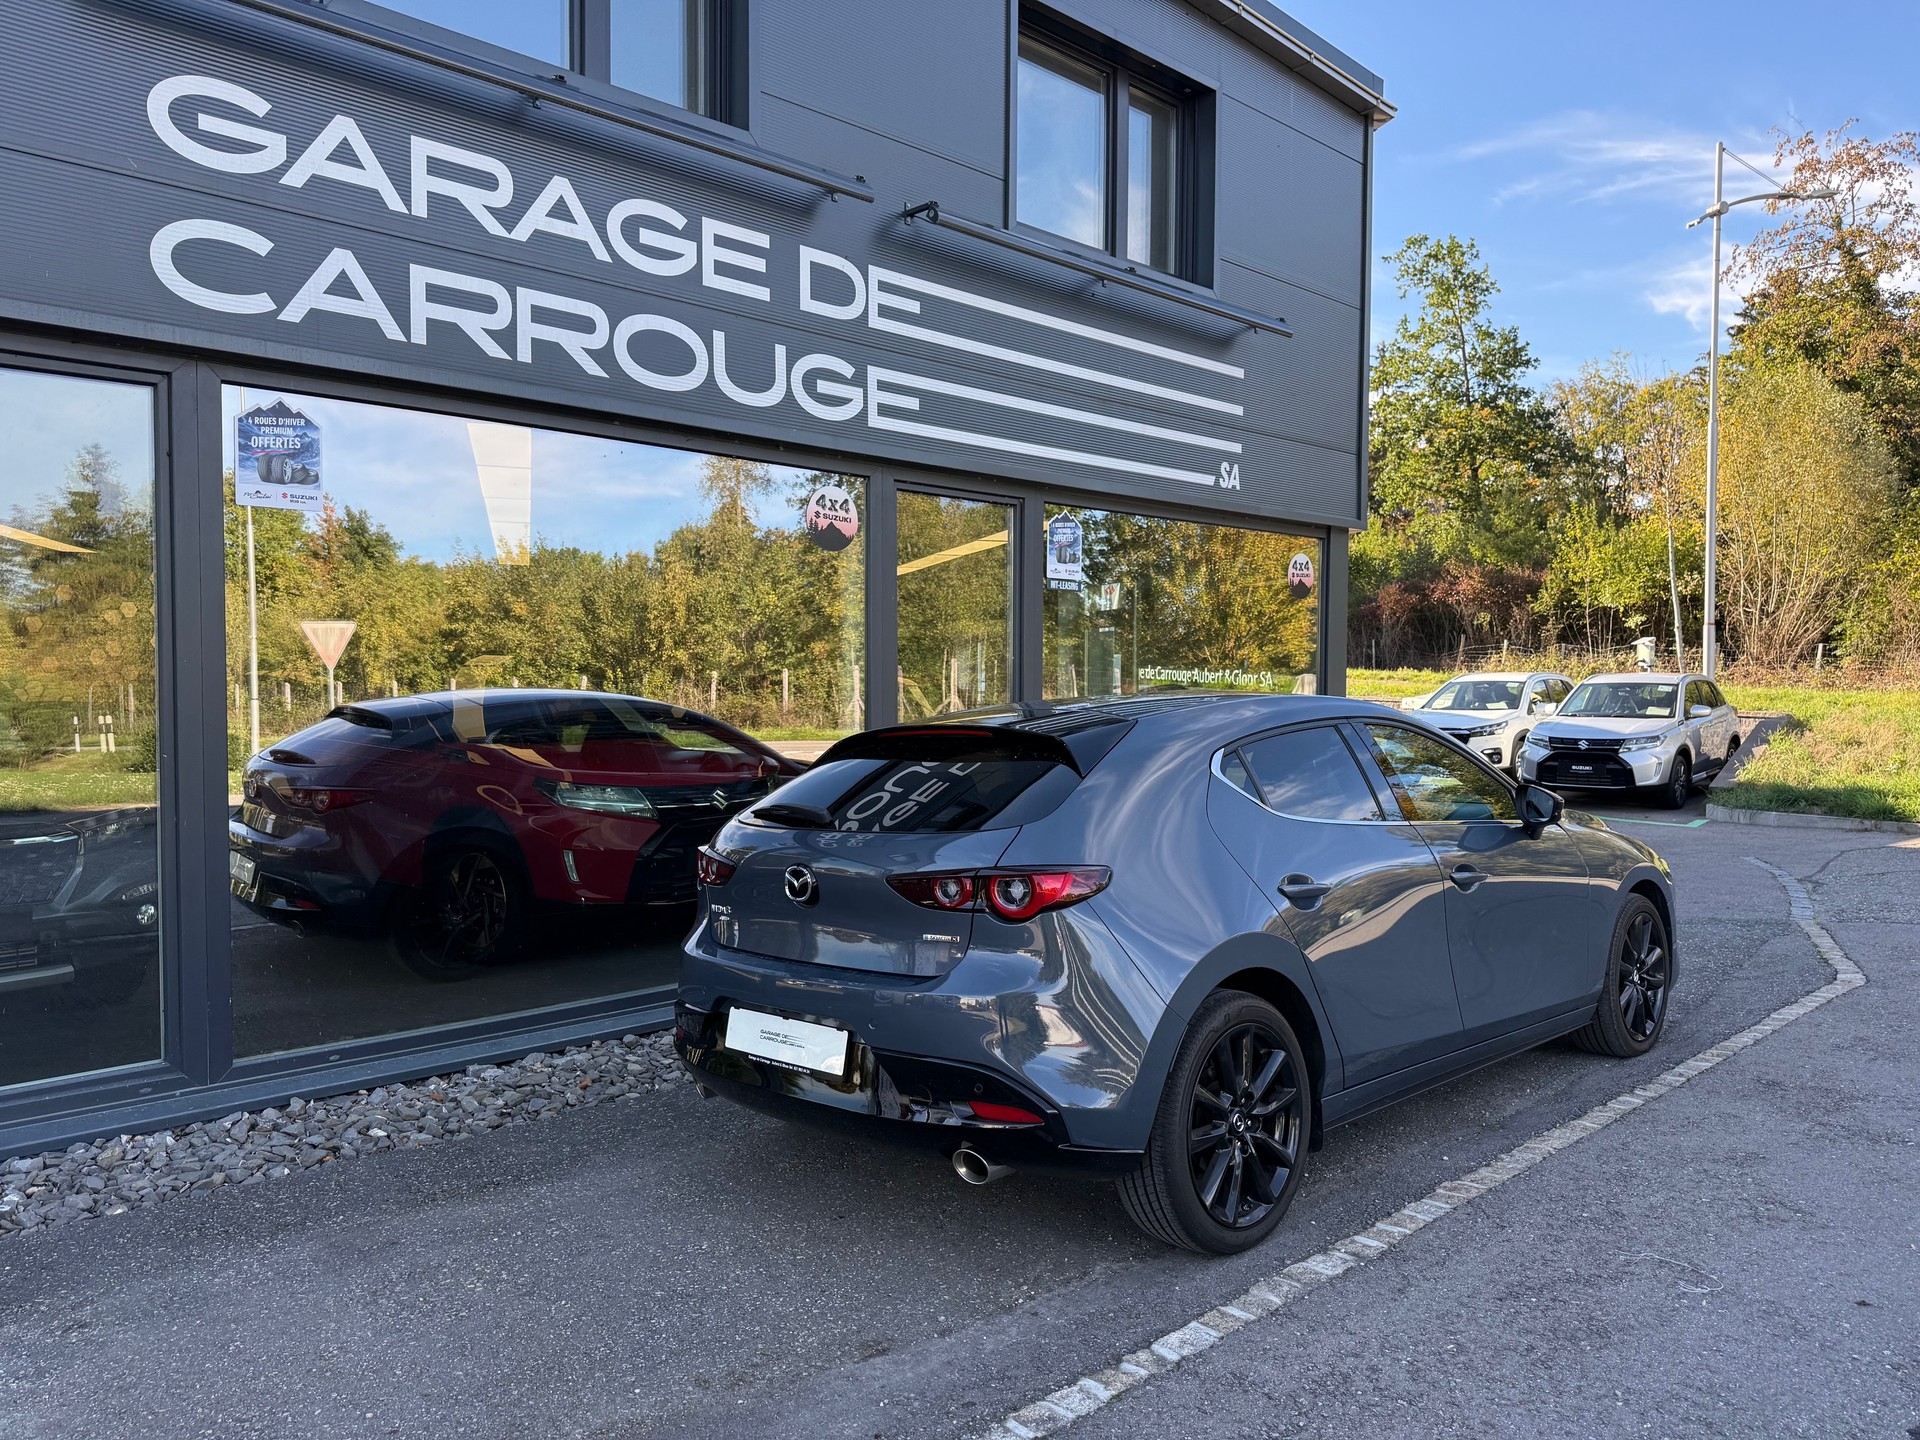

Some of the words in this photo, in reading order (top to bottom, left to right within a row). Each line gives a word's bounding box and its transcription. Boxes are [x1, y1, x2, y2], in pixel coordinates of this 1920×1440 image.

[147, 74, 771, 302] GARAGE
[149, 219, 921, 434] CARROUGE
[248, 416, 253, 424] 4
[254, 416, 277, 426] ROUES
[278, 417, 306, 427] D'HIVER
[260, 426, 293, 435] PREMIUM
[251, 436, 301, 449] OFFERTES
[1220, 461, 1240, 490] SA
[289, 493, 318, 501] SUZUKI
[815, 493, 851, 515] 4x4
[822, 512, 852, 524] SUZUKI
[1292, 560, 1310, 571] 4x4
[1259, 671, 1273, 688] SA
